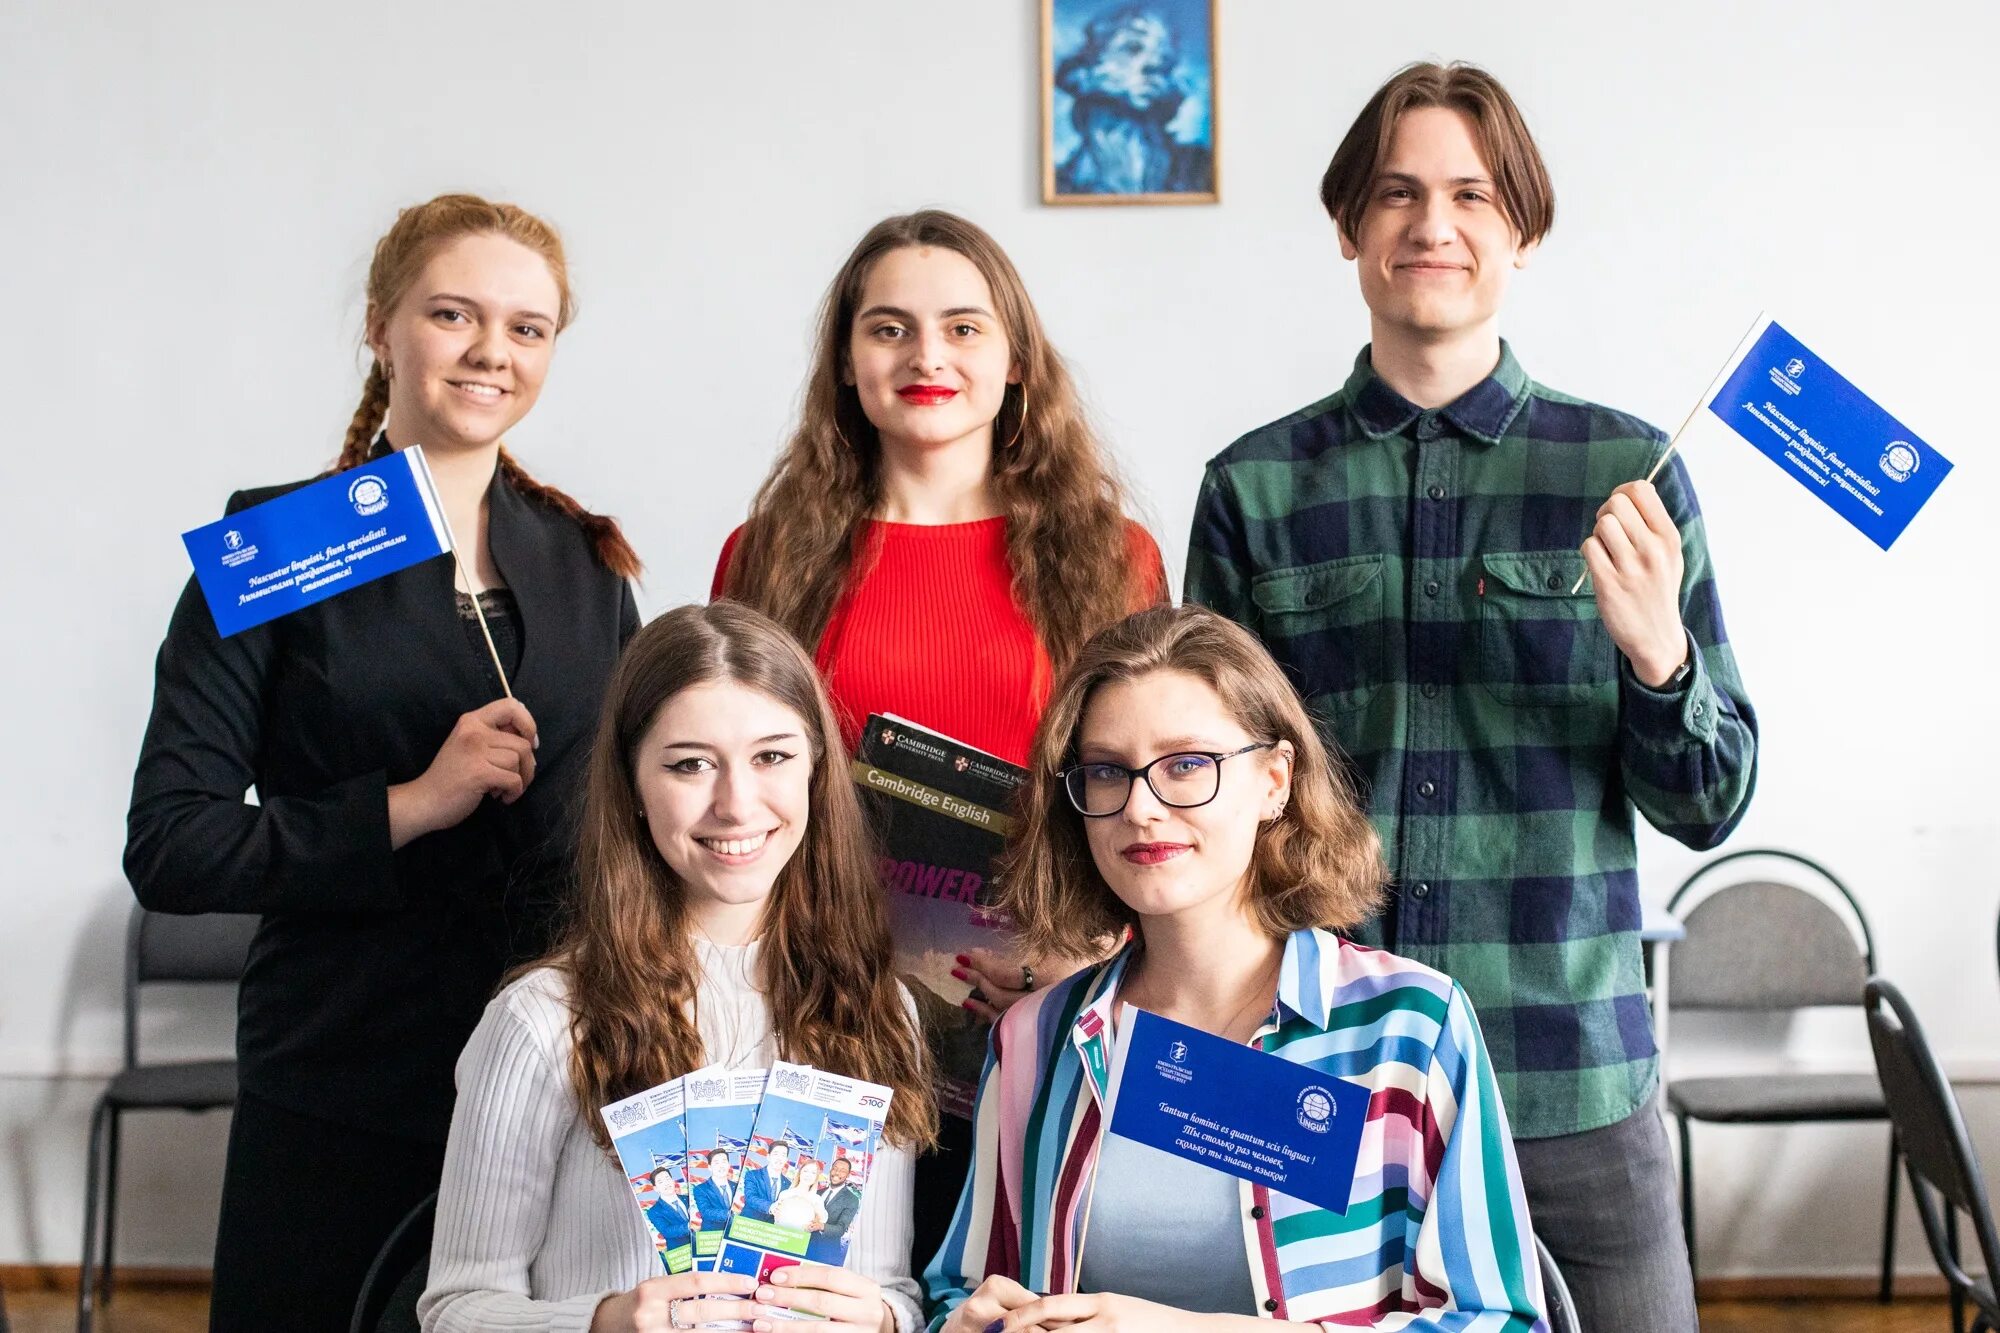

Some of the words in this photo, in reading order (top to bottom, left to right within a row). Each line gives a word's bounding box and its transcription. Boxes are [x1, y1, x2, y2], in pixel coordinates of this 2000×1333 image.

[1742, 402, 1791, 441] Лингвистами
[1788, 439, 1830, 474] рождаются,
[1830, 473, 1884, 516] специалистами
[1763, 402, 1800, 431] Nascuntur
[1824, 452, 1845, 469] fiunt
[1844, 467, 1880, 496] specialisti!
[1785, 451, 1829, 486] становятся!
[239, 579, 294, 606] Лингвистами
[345, 535, 407, 562] специалистами
[249, 566, 291, 587] Nascuntur
[325, 543, 345, 561] fiunt
[301, 566, 352, 593] становятся!
[896, 742, 927, 756] UNIVERSITY
[928, 754, 945, 763] PRESS
[897, 735, 946, 757] CAMBRIDGE
[970, 761, 1008, 779] CAMBRIDGE
[867, 770, 939, 806] Cambridge
[942, 796, 990, 824] English
[878, 858, 981, 904] POWER
[1159, 1102, 1189, 1119] Tantum
[1190, 1113, 1220, 1130] hominis
[1230, 1130, 1264, 1146] quantum
[1266, 1143, 1281, 1152] scis
[1182, 1125, 1200, 1137] Ты
[1201, 1134, 1235, 1151] столько
[1235, 1146, 1250, 1155] раз
[1299, 1117, 1327, 1132] LINGUA
[1176, 1139, 1206, 1155] сколько
[1208, 1150, 1222, 1159] ты
[1223, 1155, 1252, 1170] знаешь
[1254, 1167, 1287, 1182] языков!
[724, 1258, 733, 1268] 91
